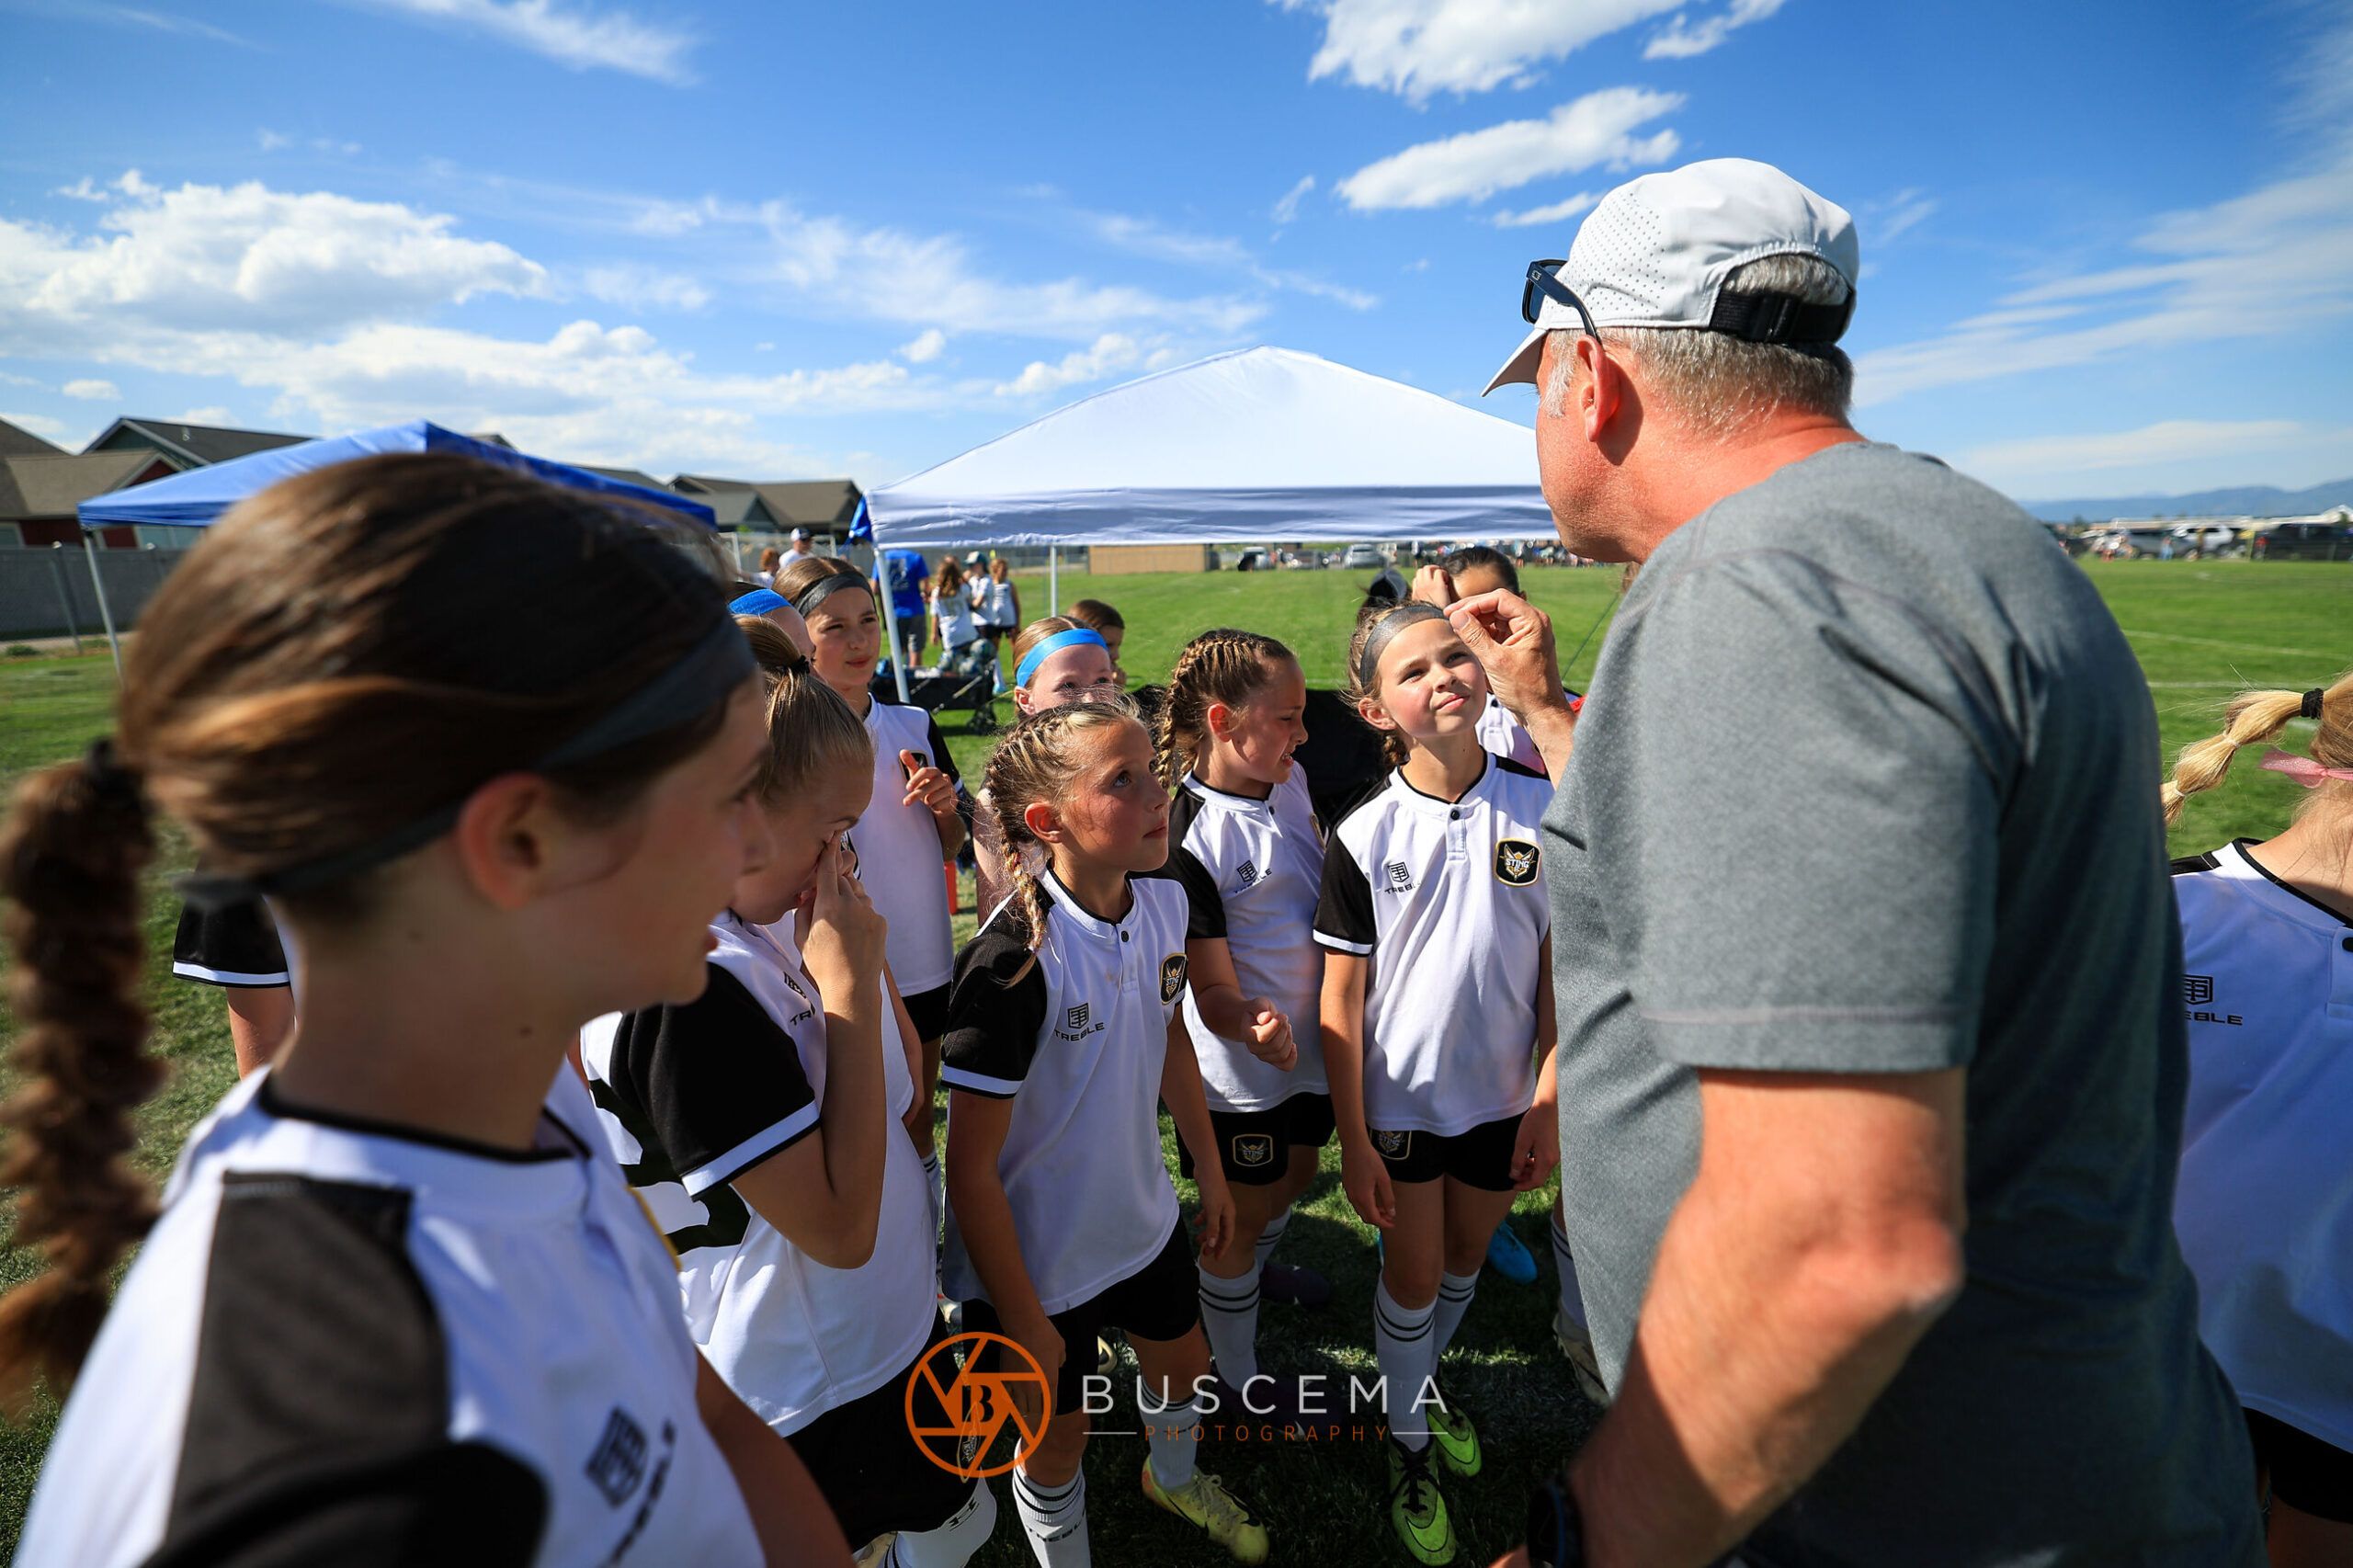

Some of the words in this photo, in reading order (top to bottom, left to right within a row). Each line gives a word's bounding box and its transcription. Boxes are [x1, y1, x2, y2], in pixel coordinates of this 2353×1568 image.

[1384, 882, 1421, 894] TREBL
[2185, 1011, 2243, 1026] EBLE
[1054, 1022, 1105, 1042] TREBLE
